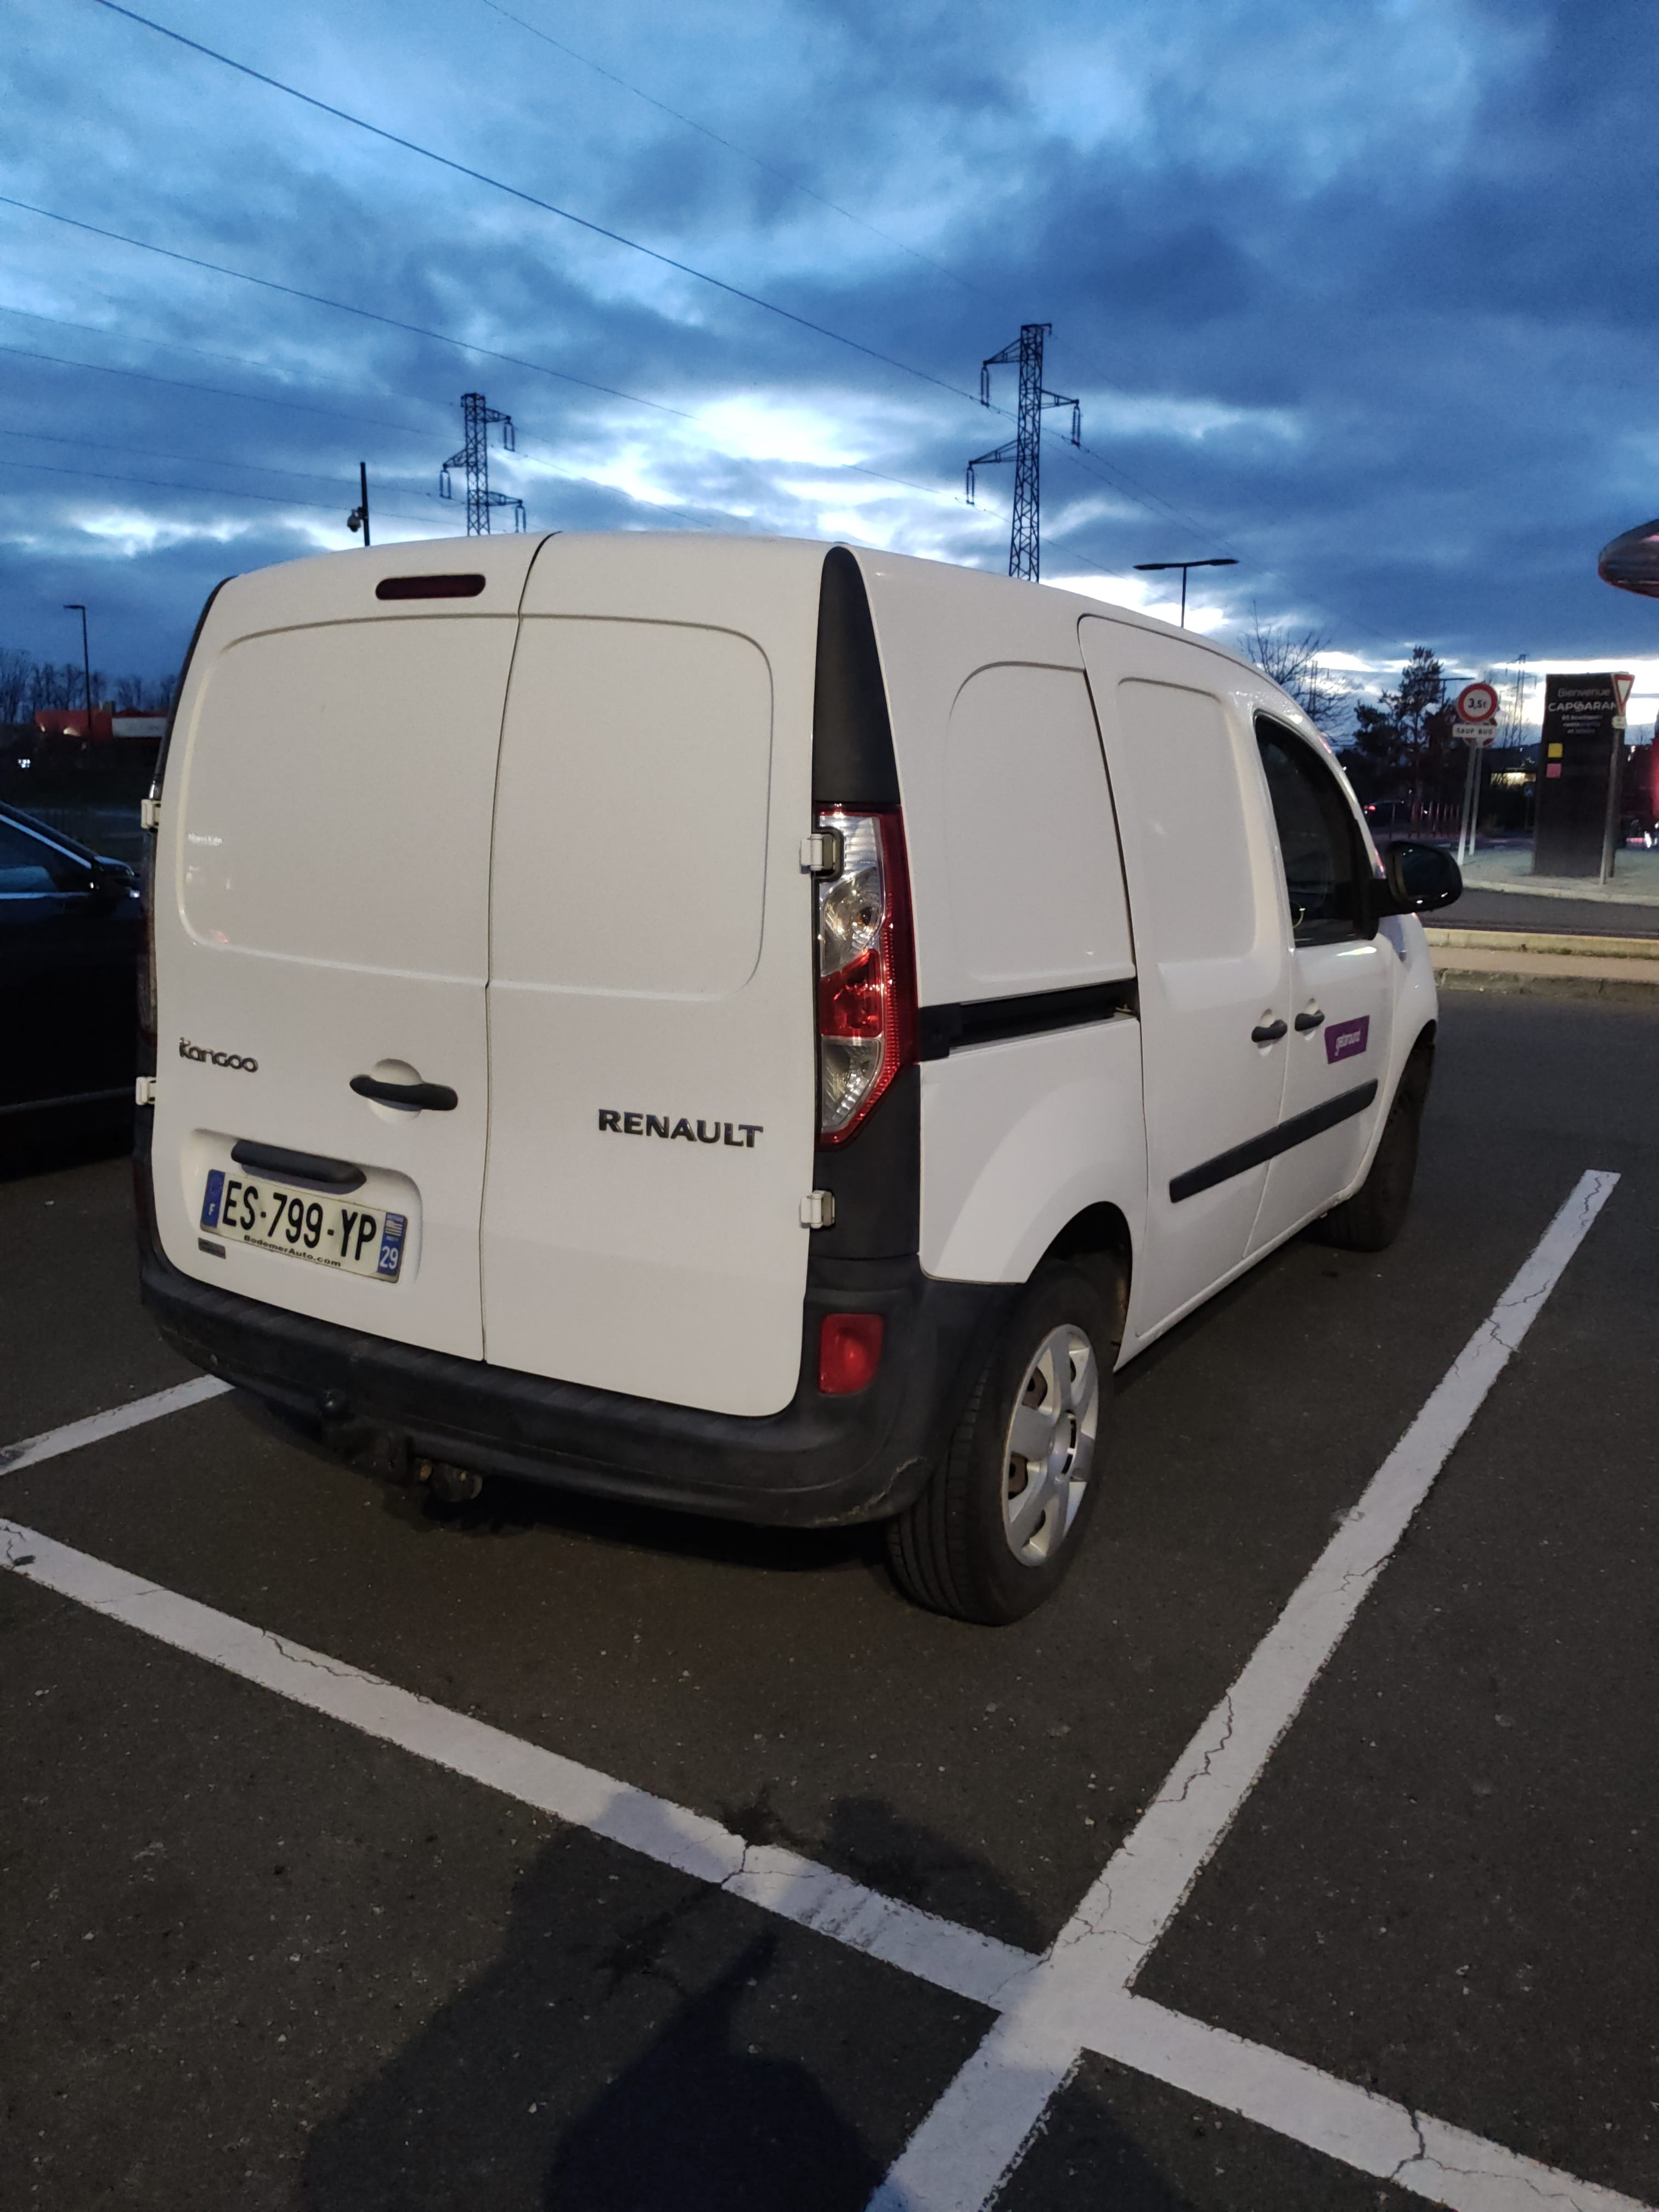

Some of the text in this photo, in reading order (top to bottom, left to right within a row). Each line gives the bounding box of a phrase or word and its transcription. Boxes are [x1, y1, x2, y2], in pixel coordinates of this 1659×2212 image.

[1558, 688, 1610, 697] Bienvenue
[598, 1109, 764, 1148] RENAULT
[208, 1203, 216, 1216] F
[222, 1180, 377, 1261] ES-799-YP
[244, 1234, 341, 1267] BodemerAuto.com
[380, 1246, 399, 1269] 29
